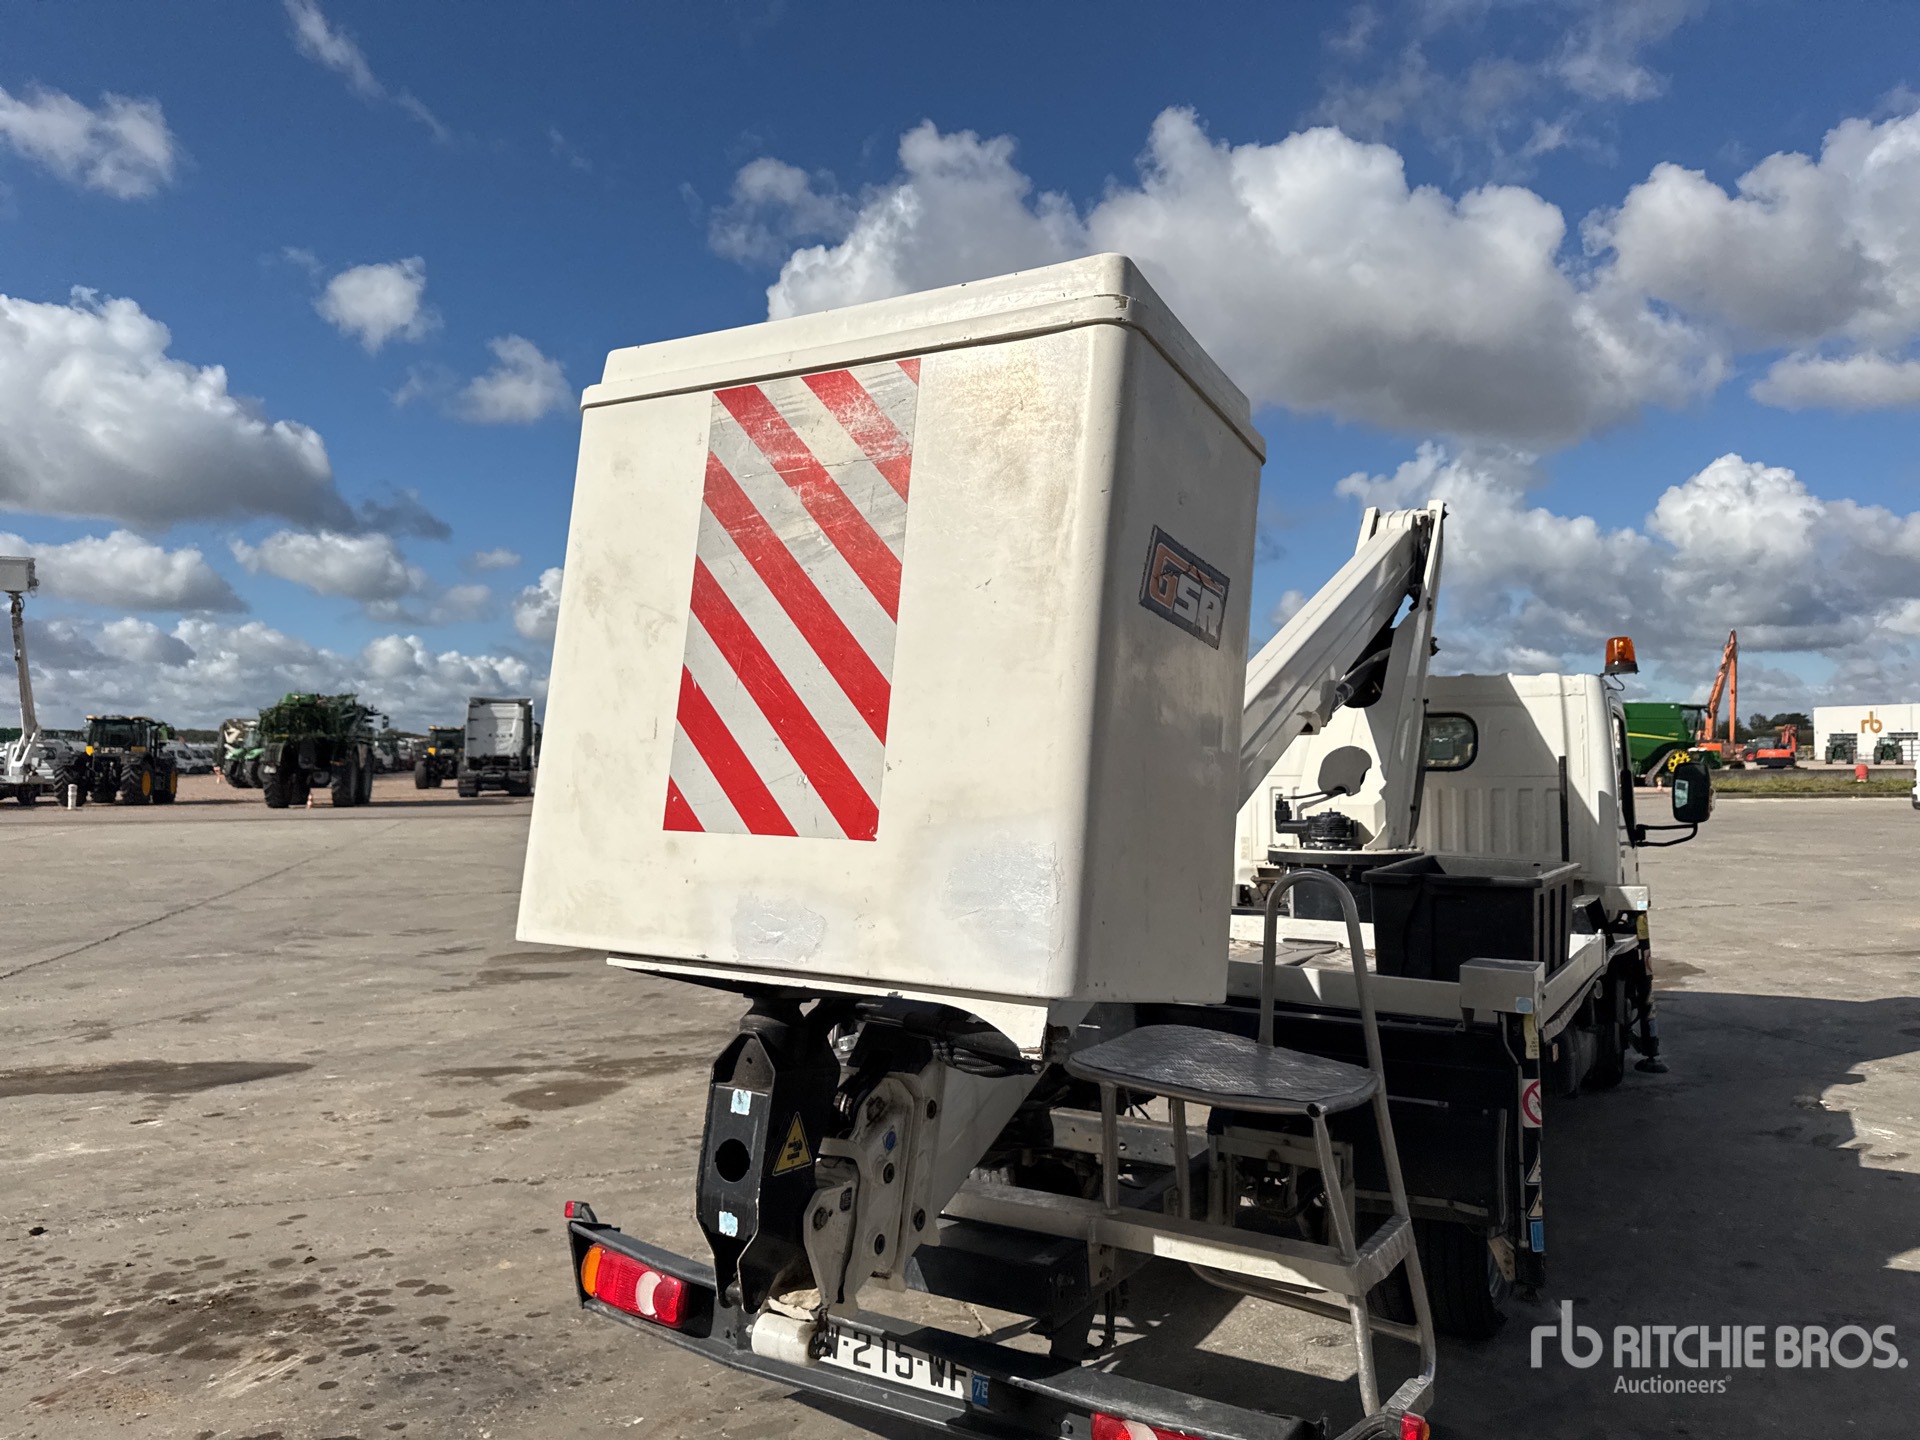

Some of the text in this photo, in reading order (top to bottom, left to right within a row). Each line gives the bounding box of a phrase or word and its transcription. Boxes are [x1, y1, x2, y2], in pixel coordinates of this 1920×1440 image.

[1149, 542, 1225, 639] GSR
[1861, 711, 1882, 733] rb
[814, 1324, 989, 1399] W-215-WF 78
